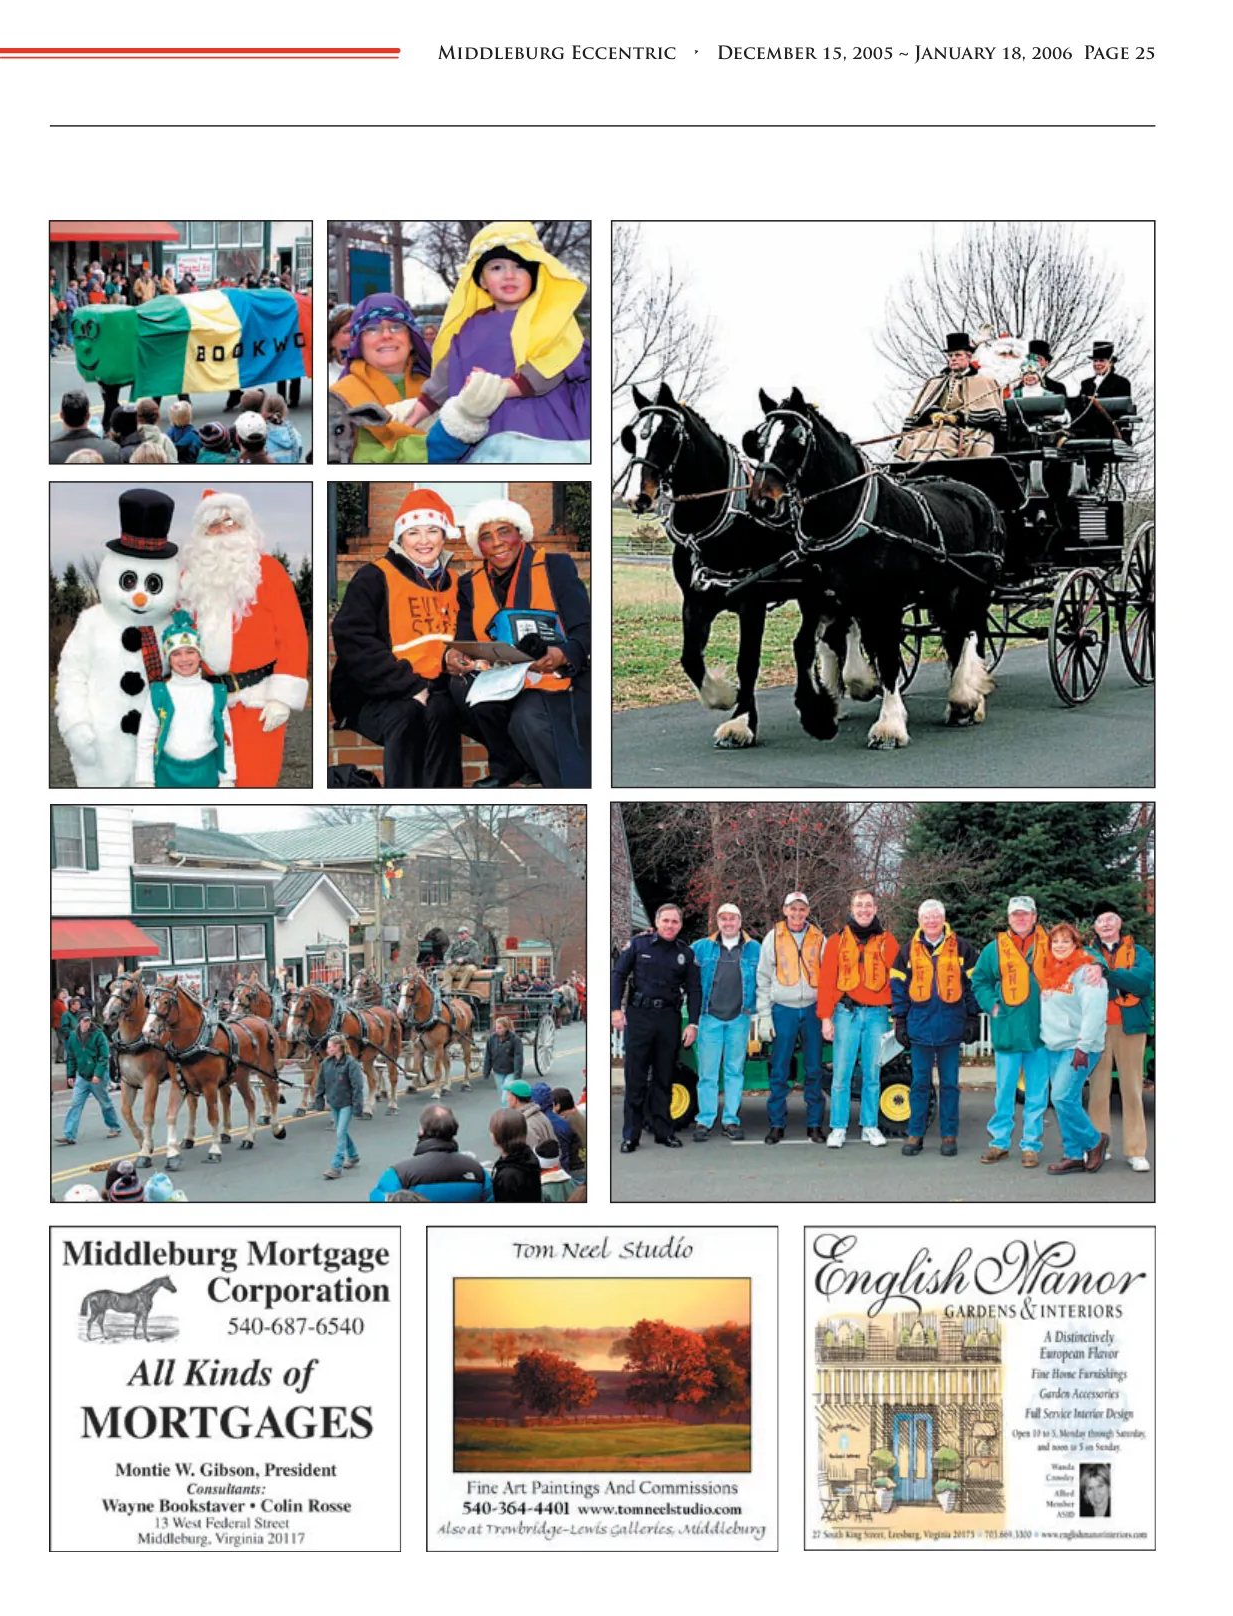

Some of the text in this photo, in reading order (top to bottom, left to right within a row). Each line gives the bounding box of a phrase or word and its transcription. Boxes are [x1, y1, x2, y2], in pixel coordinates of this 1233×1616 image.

[824, 47, 846, 61] 15,
[853, 47, 892, 59] 2005
[1003, 47, 1025, 61] 18,
[1032, 47, 1072, 59] 2006
[1136, 47, 1154, 59] 25
[513, 1236, 693, 1258] Tom Neel Studio
[63, 1241, 389, 1273] Middleburg Mortgage
[813, 1233, 1147, 1317] English Manor
[208, 1277, 389, 1309] Corporation
[944, 1296, 1123, 1320] GARDENS & INTERIORS
[228, 1318, 364, 1335] 540-687-6540
[1044, 1331, 1115, 1346] A Distinctively
[1039, 1348, 1119, 1363] European Flavor
[127, 1359, 319, 1394] All Kinds of
[81, 1406, 373, 1439] MORTGAGES
[116, 1463, 336, 1477] Montie W. Gibson, President
[187, 1483, 265, 1494] Consultants:
[467, 1480, 738, 1498] Fine Art Paintings And Commissions
[103, 1499, 351, 1516] Wayne Bookstaver Colin Rosse
[463, 1502, 741, 1515] 540-364-4401 www.tomneelstudio.com
[156, 1517, 288, 1529] 13 West Federal Street
[437, 1521, 466, 1536] Also
[467, 1523, 483, 1536] at
[678, 1521, 766, 1540] Middleburg
[138, 1532, 306, 1546] Middleburg, Virginia 20117
